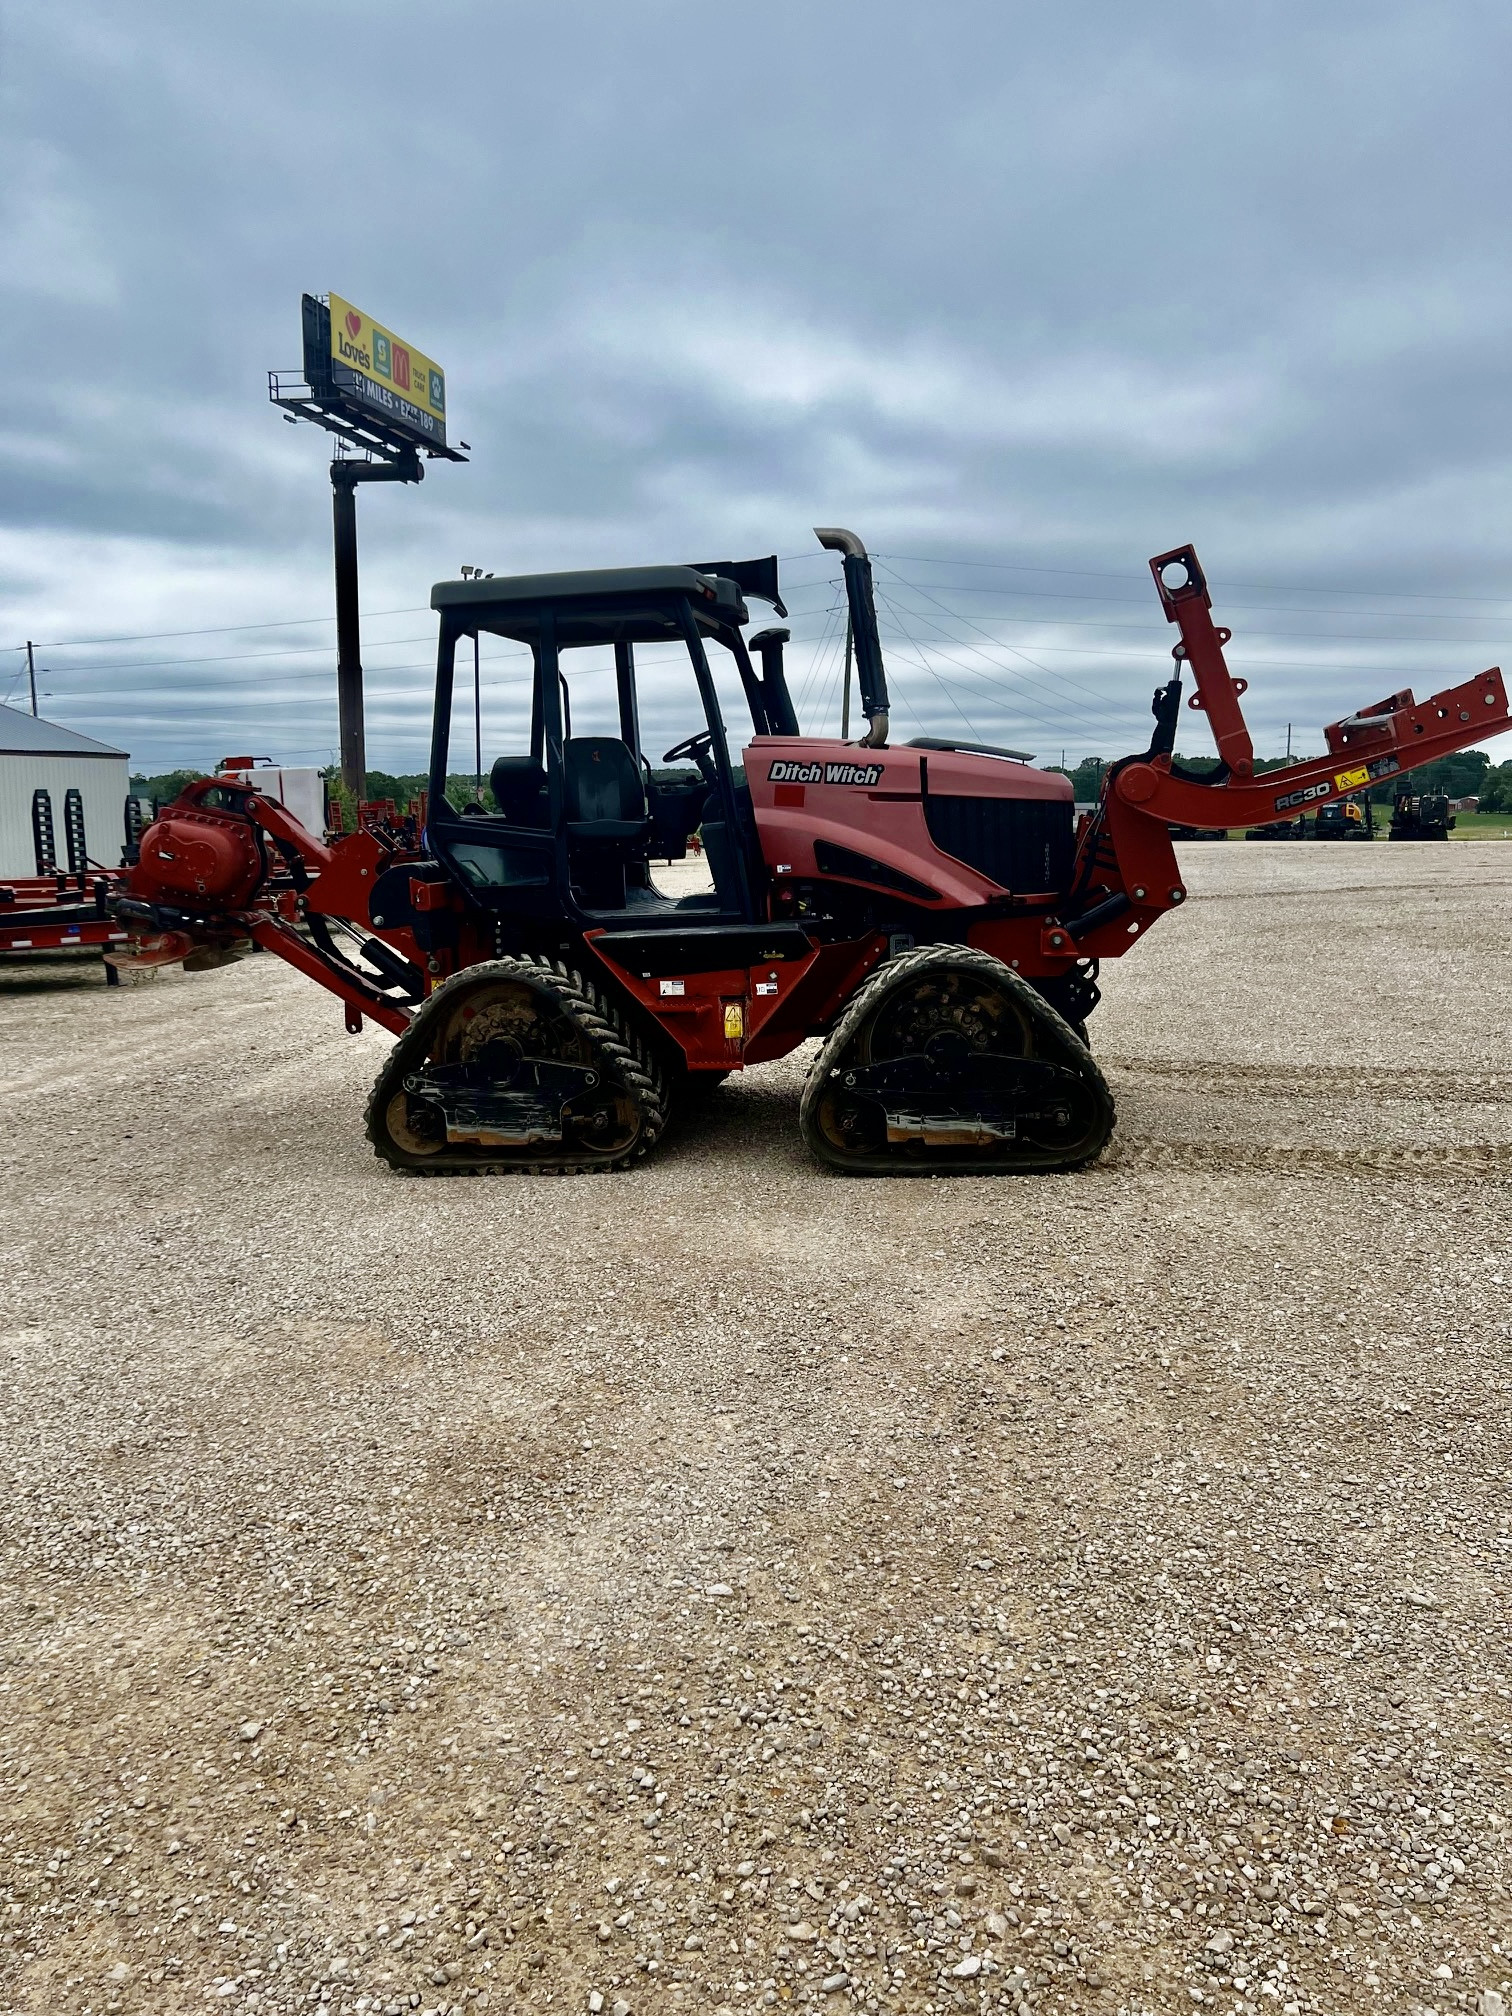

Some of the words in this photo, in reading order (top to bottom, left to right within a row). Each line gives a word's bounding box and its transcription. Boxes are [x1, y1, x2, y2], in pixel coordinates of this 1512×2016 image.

[338, 332, 371, 371] Love's
[366, 380, 393, 409] MILES
[419, 410, 434, 431] 189
[770, 762, 821, 782] Ditch
[826, 764, 878, 784] Witch
[1276, 782, 1331, 810] RC30
